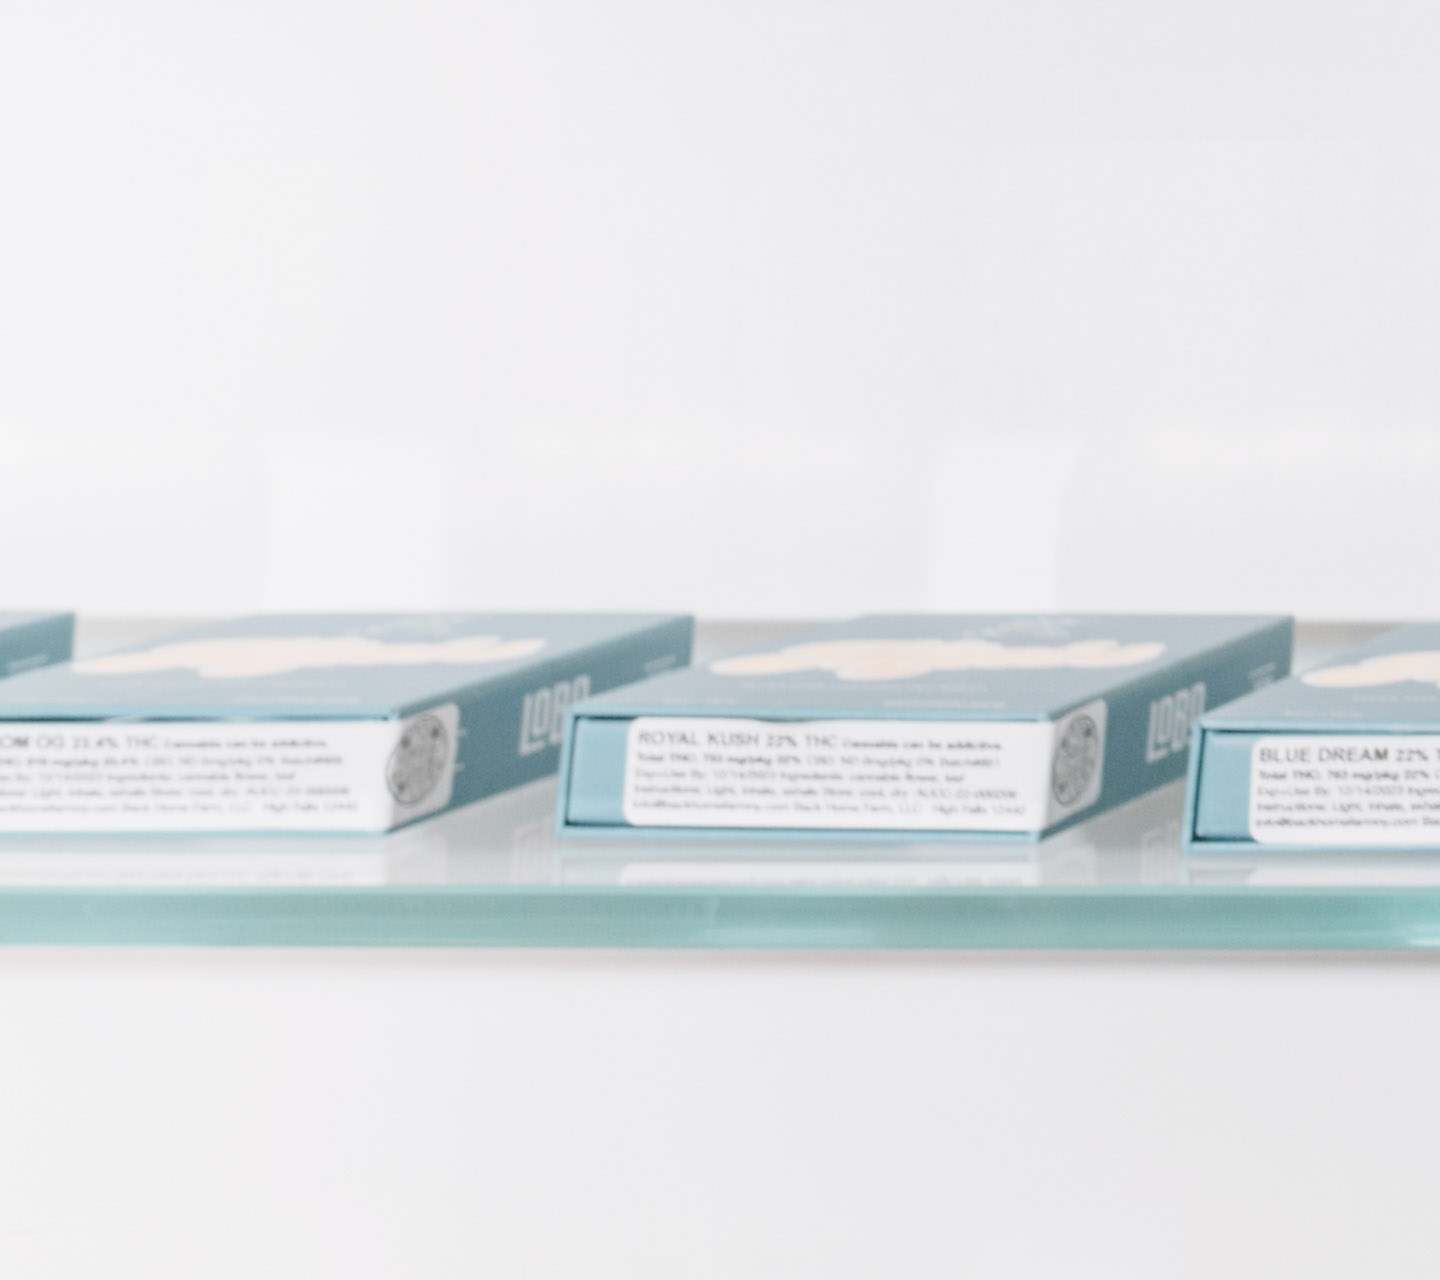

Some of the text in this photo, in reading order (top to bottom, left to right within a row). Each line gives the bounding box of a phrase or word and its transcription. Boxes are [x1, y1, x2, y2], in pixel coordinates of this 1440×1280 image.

[637, 730, 698, 747] ROYAL
[705, 730, 761, 748] KUSH
[804, 732, 839, 748] THC
[1258, 746, 1311, 763] BLUE
[1317, 746, 1389, 763] DREAM
